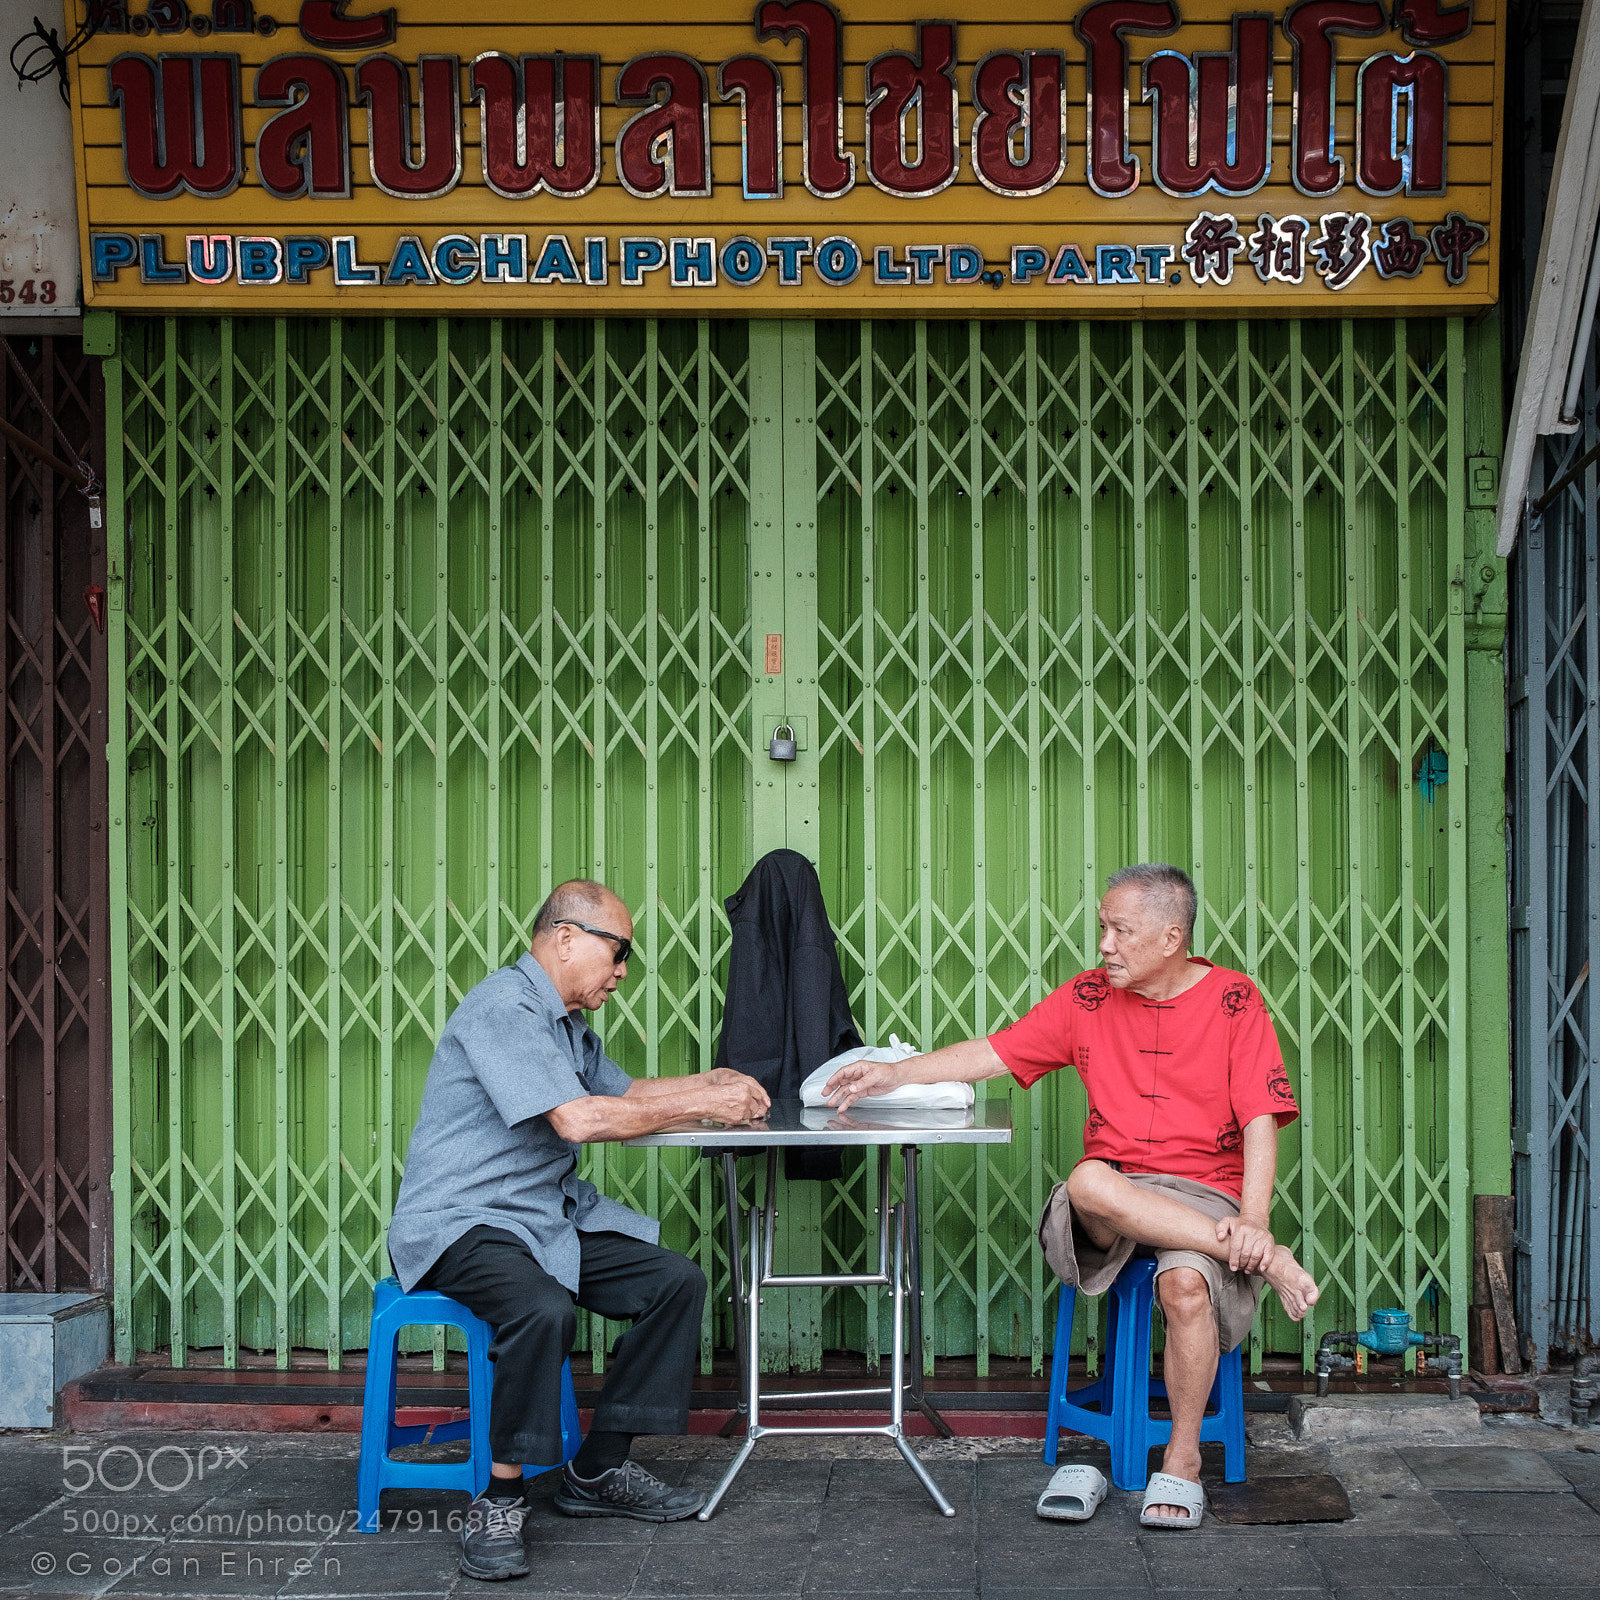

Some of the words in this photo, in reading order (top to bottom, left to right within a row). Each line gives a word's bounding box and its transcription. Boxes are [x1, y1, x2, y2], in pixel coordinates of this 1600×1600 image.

[91, 232, 608, 286] PLUBPLACHAI
[619, 235, 863, 287] PHOTO
[1010, 244, 1182, 285] PART.
[1159, 1477, 1185, 1487] ADDA
